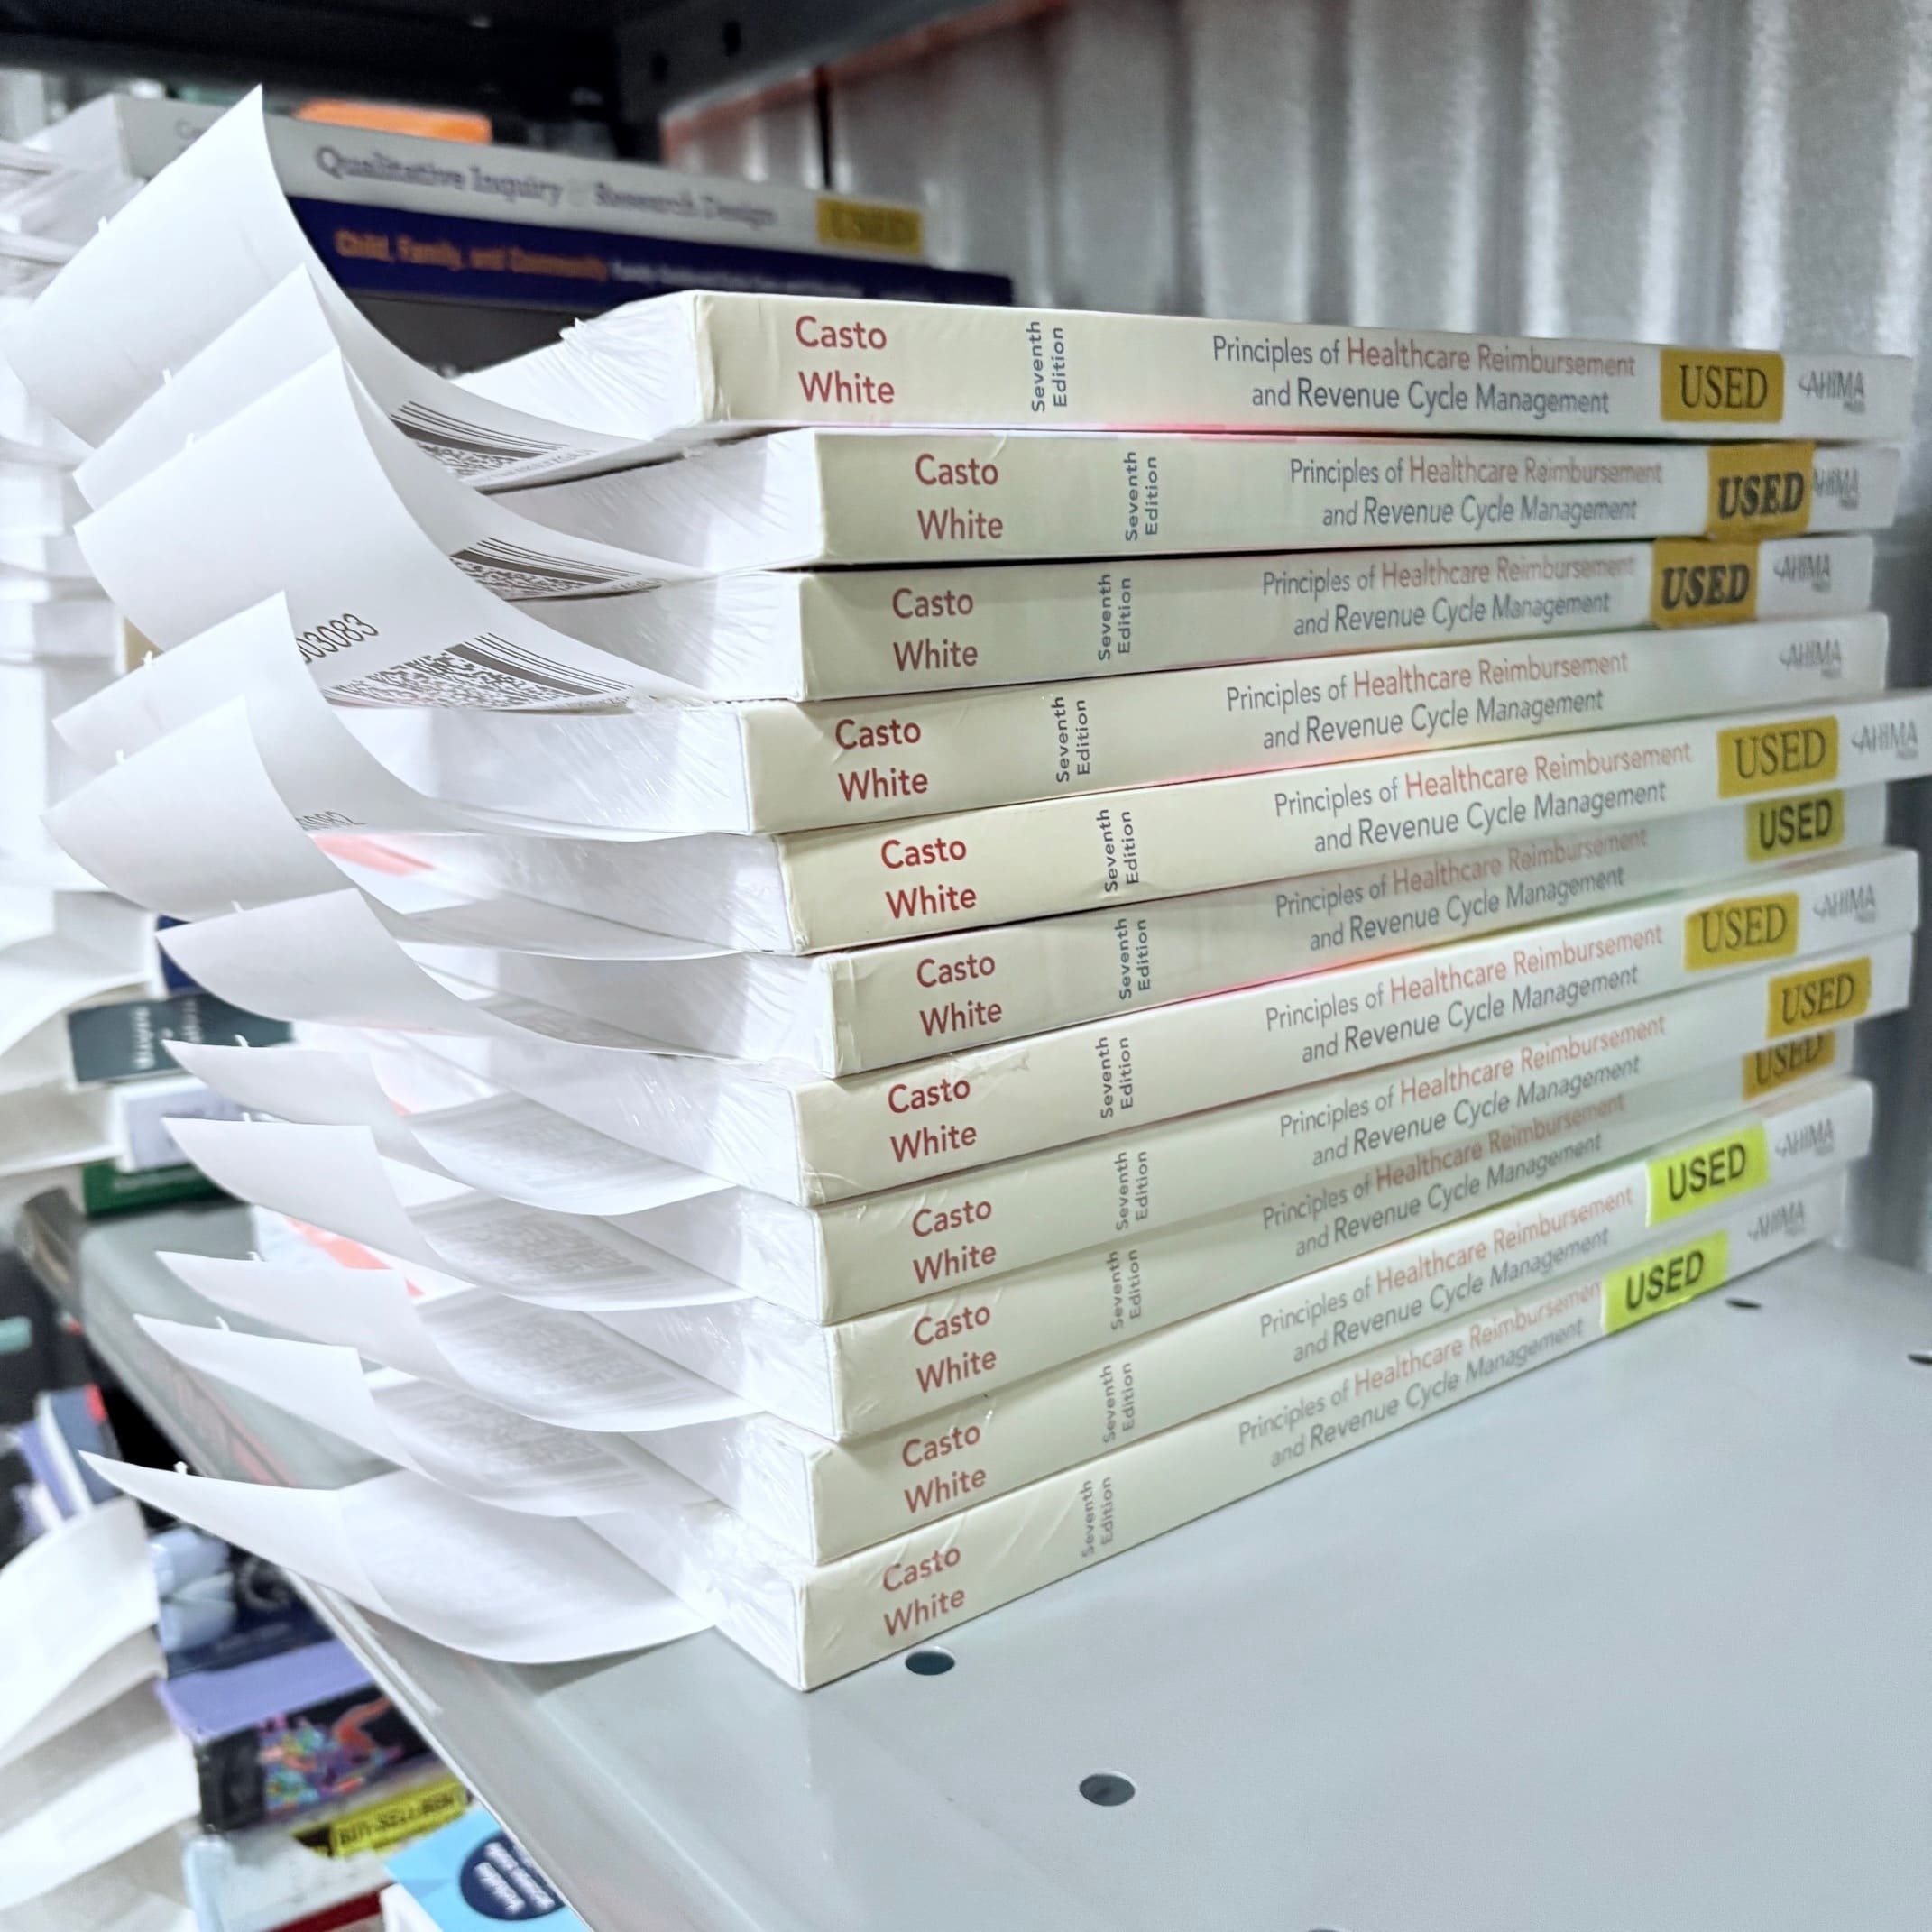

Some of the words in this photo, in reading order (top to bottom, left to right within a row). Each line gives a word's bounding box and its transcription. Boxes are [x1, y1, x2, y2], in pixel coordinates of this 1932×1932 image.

[796, 315, 888, 350] Casto
[1213, 336, 1313, 372] Principles
[1320, 339, 1341, 364] of
[1347, 337, 1470, 371] Healthcare
[1478, 345, 1636, 377] Reimbursement
[797, 370, 896, 404] White
[1026, 321, 1046, 412] Seventh
[1051, 327, 1068, 408] Edition
[1680, 364, 1768, 409] USED
[1252, 381, 1291, 407] and
[1298, 377, 1400, 408] Revenue
[1408, 381, 1468, 418] Cycle
[1476, 383, 1610, 419] Management
[915, 453, 999, 486] Casto
[1125, 451, 1138, 541] Seventh
[1145, 455, 1158, 536] Edition
[1291, 458, 1379, 490] Principles
[1385, 458, 1403, 483] of
[1410, 455, 1517, 484] Healthcare
[1717, 471, 1805, 520] USED
[917, 507, 1004, 540] White
[1322, 501, 1357, 527] and
[1363, 497, 1454, 527] Revenue
[1461, 495, 1513, 531] Cycle
[1521, 495, 1638, 529] Management
[891, 587, 974, 618] Casto
[1263, 571, 1350, 603] Principles
[1357, 566, 1375, 591] of
[1382, 557, 1490, 589] Healthcare
[1661, 563, 1751, 610] USED
[1098, 573, 1111, 661] Seventh
[1118, 576, 1132, 654] Edition
[1293, 609, 1329, 637] and
[1335, 603, 1425, 633] Revenue
[1433, 597, 1486, 632] Cycle
[1493, 591, 1611, 625] Management
[893, 640, 979, 671] White
[1228, 680, 1321, 714] Principles
[1328, 676, 1348, 702] of
[1353, 663, 1472, 697] Healthcare
[1478, 651, 1629, 685] Reimbursement
[834, 716, 922, 750] Casto
[1052, 695, 1070, 783] Seventh
[1075, 698, 1090, 776] Edition
[1263, 721, 1300, 750] and
[1307, 713, 1403, 744] Revenue
[1411, 702, 1469, 740] Cycle
[1476, 689, 1604, 725] Management
[1274, 784, 1372, 818] Principles
[1379, 777, 1400, 804] of
[1405, 763, 1529, 799] Healthcare
[1535, 742, 1692, 781] Reimbursement
[1734, 728, 1826, 779] USED
[838, 768, 929, 802] White
[1314, 824, 1353, 853] and
[1358, 814, 1459, 846] Revenue
[1467, 801, 1527, 838] Cycle
[1533, 781, 1667, 818] Management
[1759, 799, 1833, 851] USED
[880, 837, 967, 869] Casto
[1096, 809, 1118, 893] Seventh
[1120, 811, 1139, 885] Edition
[885, 884, 977, 919] White
[1276, 886, 1365, 919] Principles
[1369, 880, 1389, 901] of
[1393, 857, 1502, 897] Healthcare
[1310, 925, 1345, 952] and
[1349, 910, 1440, 944] Revenue
[1447, 891, 1500, 928] Cycle
[1506, 866, 1624, 910] Management
[1133, 918, 1150, 991] Edition
[1700, 902, 1788, 953] USED
[916, 954, 996, 989] Casto
[1114, 917, 1132, 1000] Seventh
[1265, 998, 1359, 1033] Principles
[1365, 989, 1385, 1009] of
[1390, 962, 1507, 1004] Healthcare
[1513, 925, 1664, 975] Reimbursement
[919, 1001, 1003, 1037] White
[1302, 1037, 1339, 1063] and
[1344, 1018, 1440, 1053] Revenue
[1447, 998, 1505, 1030] Cycle
[1512, 964, 1640, 1008] Management
[1782, 973, 1855, 1025] USED
[1096, 1036, 1114, 1119] Seventh
[1120, 1036, 1134, 1109] Edition
[1279, 1103, 1369, 1137] Principles
[1375, 1089, 1395, 1113] of
[1400, 1057, 1514, 1105] Healthcare
[1520, 1015, 1667, 1071] Reimbursement
[1754, 1035, 1825, 1084] USED
[888, 1079, 971, 1114] Casto
[1313, 1140, 1348, 1168] and
[1353, 1120, 1447, 1155] Revenue
[1453, 1094, 1510, 1130] Cycle
[1516, 1054, 1641, 1109] Management
[890, 1125, 977, 1163] White
[1668, 1144, 1746, 1201] USED
[1114, 1152, 1128, 1230] Seventh
[1136, 1150, 1148, 1222] Edition
[1263, 1191, 1348, 1230] Principles
[1353, 1176, 1371, 1201] of
[1375, 1145, 1483, 1191] Healthcare
[1296, 1230, 1329, 1257] and
[1334, 1210, 1421, 1244] Revenue
[1427, 1180, 1481, 1218] Cycle
[1486, 1135, 1602, 1190] Management
[912, 1201, 992, 1237] Casto
[913, 1245, 997, 1284] White
[1106, 1251, 1125, 1330] Seventh
[1128, 1249, 1142, 1320] Edition
[1261, 1299, 1348, 1338] Principles
[1353, 1278, 1372, 1303] of
[1376, 1242, 1487, 1294] Healthcare
[1493, 1188, 1634, 1249] Reimbursement
[1626, 1250, 1705, 1311] USED
[914, 1305, 991, 1346] Casto
[1293, 1336, 1328, 1363] and
[1332, 1309, 1423, 1346] Revenue
[1429, 1278, 1484, 1315] Cycle
[1490, 1228, 1610, 1286] Management
[916, 1351, 997, 1393] White
[1238, 1398, 1326, 1444] Principles
[1331, 1378, 1350, 1405] of
[1355, 1340, 1464, 1395] Healthcare
[1469, 1281, 1602, 1349] Reimbursemen
[1270, 1440, 1305, 1468] and
[1310, 1395, 1401, 1449] Revenue
[1405, 1368, 1459, 1409] Cycle
[1465, 1317, 1586, 1384] Management
[1099, 1365, 1117, 1443] Seventh
[1122, 1362, 1136, 1432] Edition
[902, 1425, 981, 1468] Casto
[904, 1468, 987, 1514] White
[1081, 1481, 1095, 1558] Seventh
[1101, 1477, 1114, 1545] Edition
[882, 1546, 961, 1592] Casto
[884, 1588, 966, 1637] White
